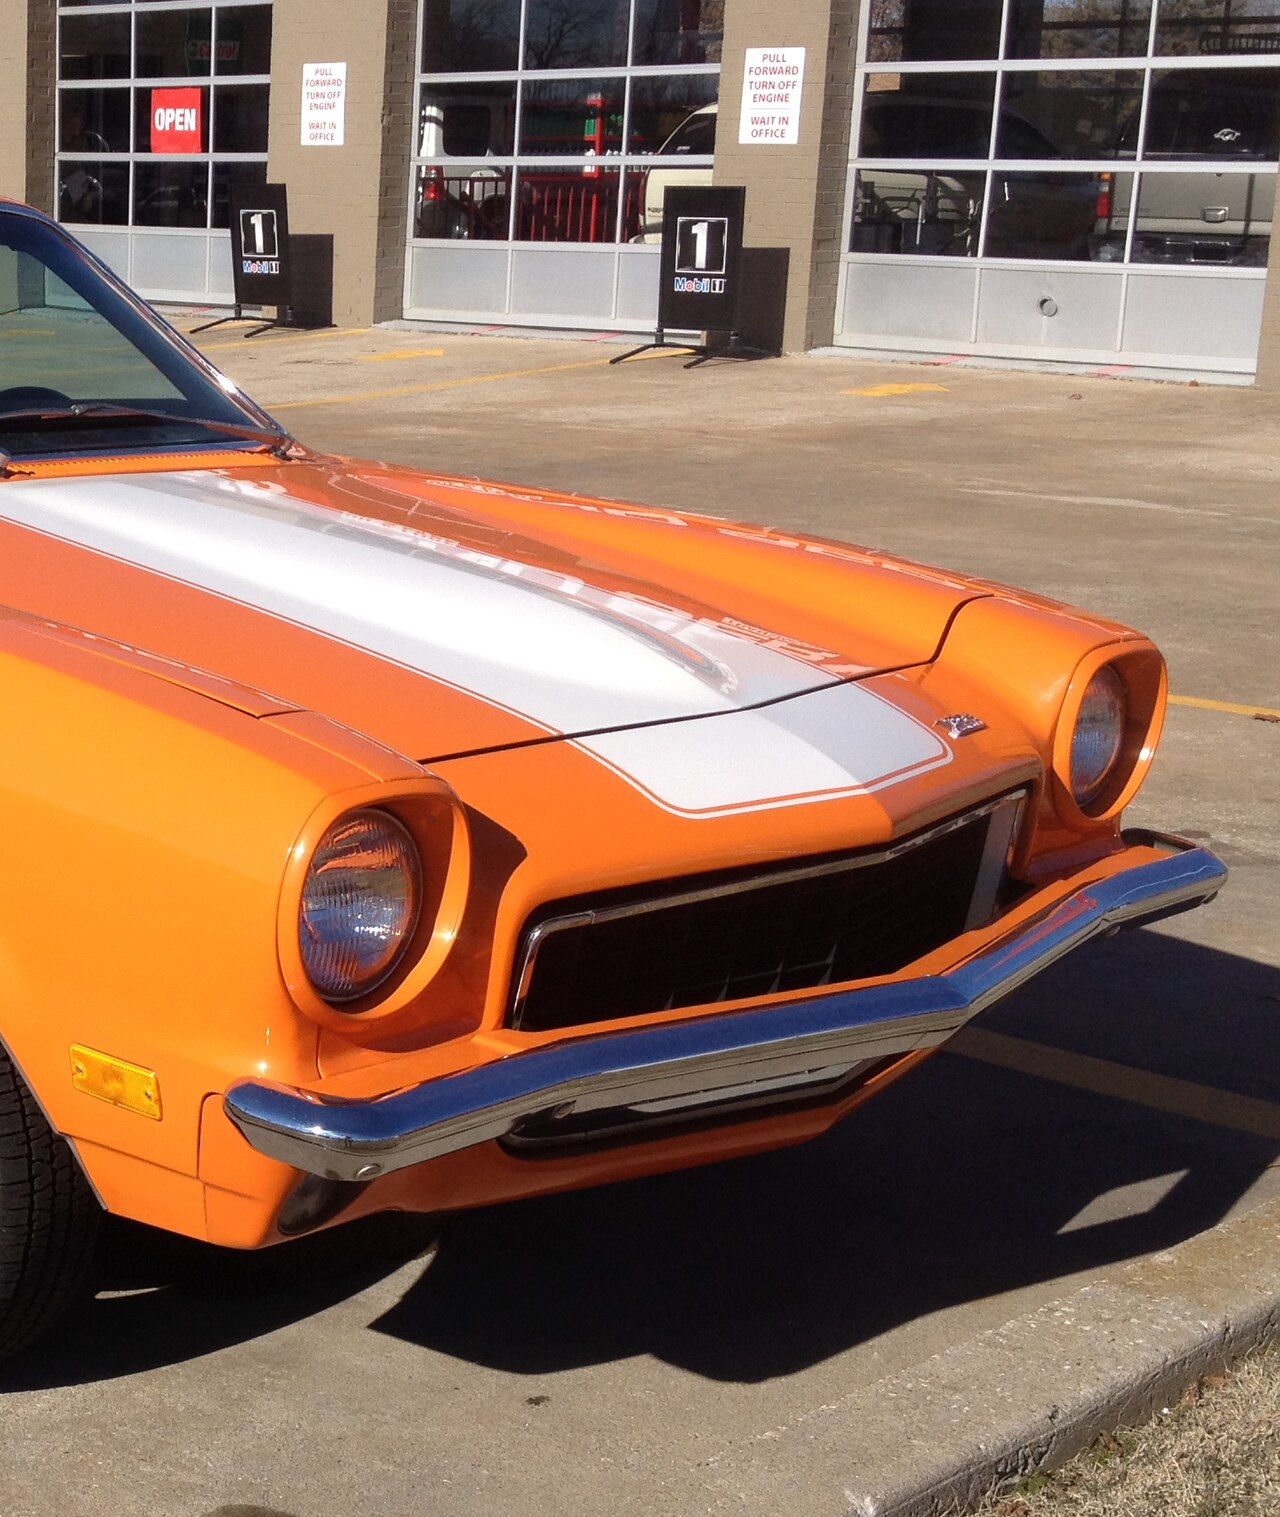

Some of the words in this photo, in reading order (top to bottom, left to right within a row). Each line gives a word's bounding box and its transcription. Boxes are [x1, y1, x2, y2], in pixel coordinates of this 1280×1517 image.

[199, 42, 237, 58] Catrol
[762, 53, 787, 63] PULL
[314, 68, 333, 76] PULL
[748, 66, 799, 76] FORWARD
[305, 78, 343, 87] FORWARD
[749, 81, 775, 90] TURN
[778, 80, 797, 90] OFF
[306, 91, 325, 100] TURN
[327, 91, 341, 99] OFF
[752, 93, 790, 103] ENGINE
[309, 102, 336, 111] ENGINE
[154, 108, 196, 131] OPEN
[751, 116, 776, 126] WAIT
[778, 116, 789, 126] IN
[309, 121, 327, 130] WAIT
[329, 121, 337, 130] IN
[309, 132, 335, 141] OFFICE
[751, 129, 786, 138] OFFICE
[250, 213, 264, 253] 1
[691, 221, 708, 269] 1
[243, 260, 269, 274] Mobil
[674, 277, 710, 293] Mobil
